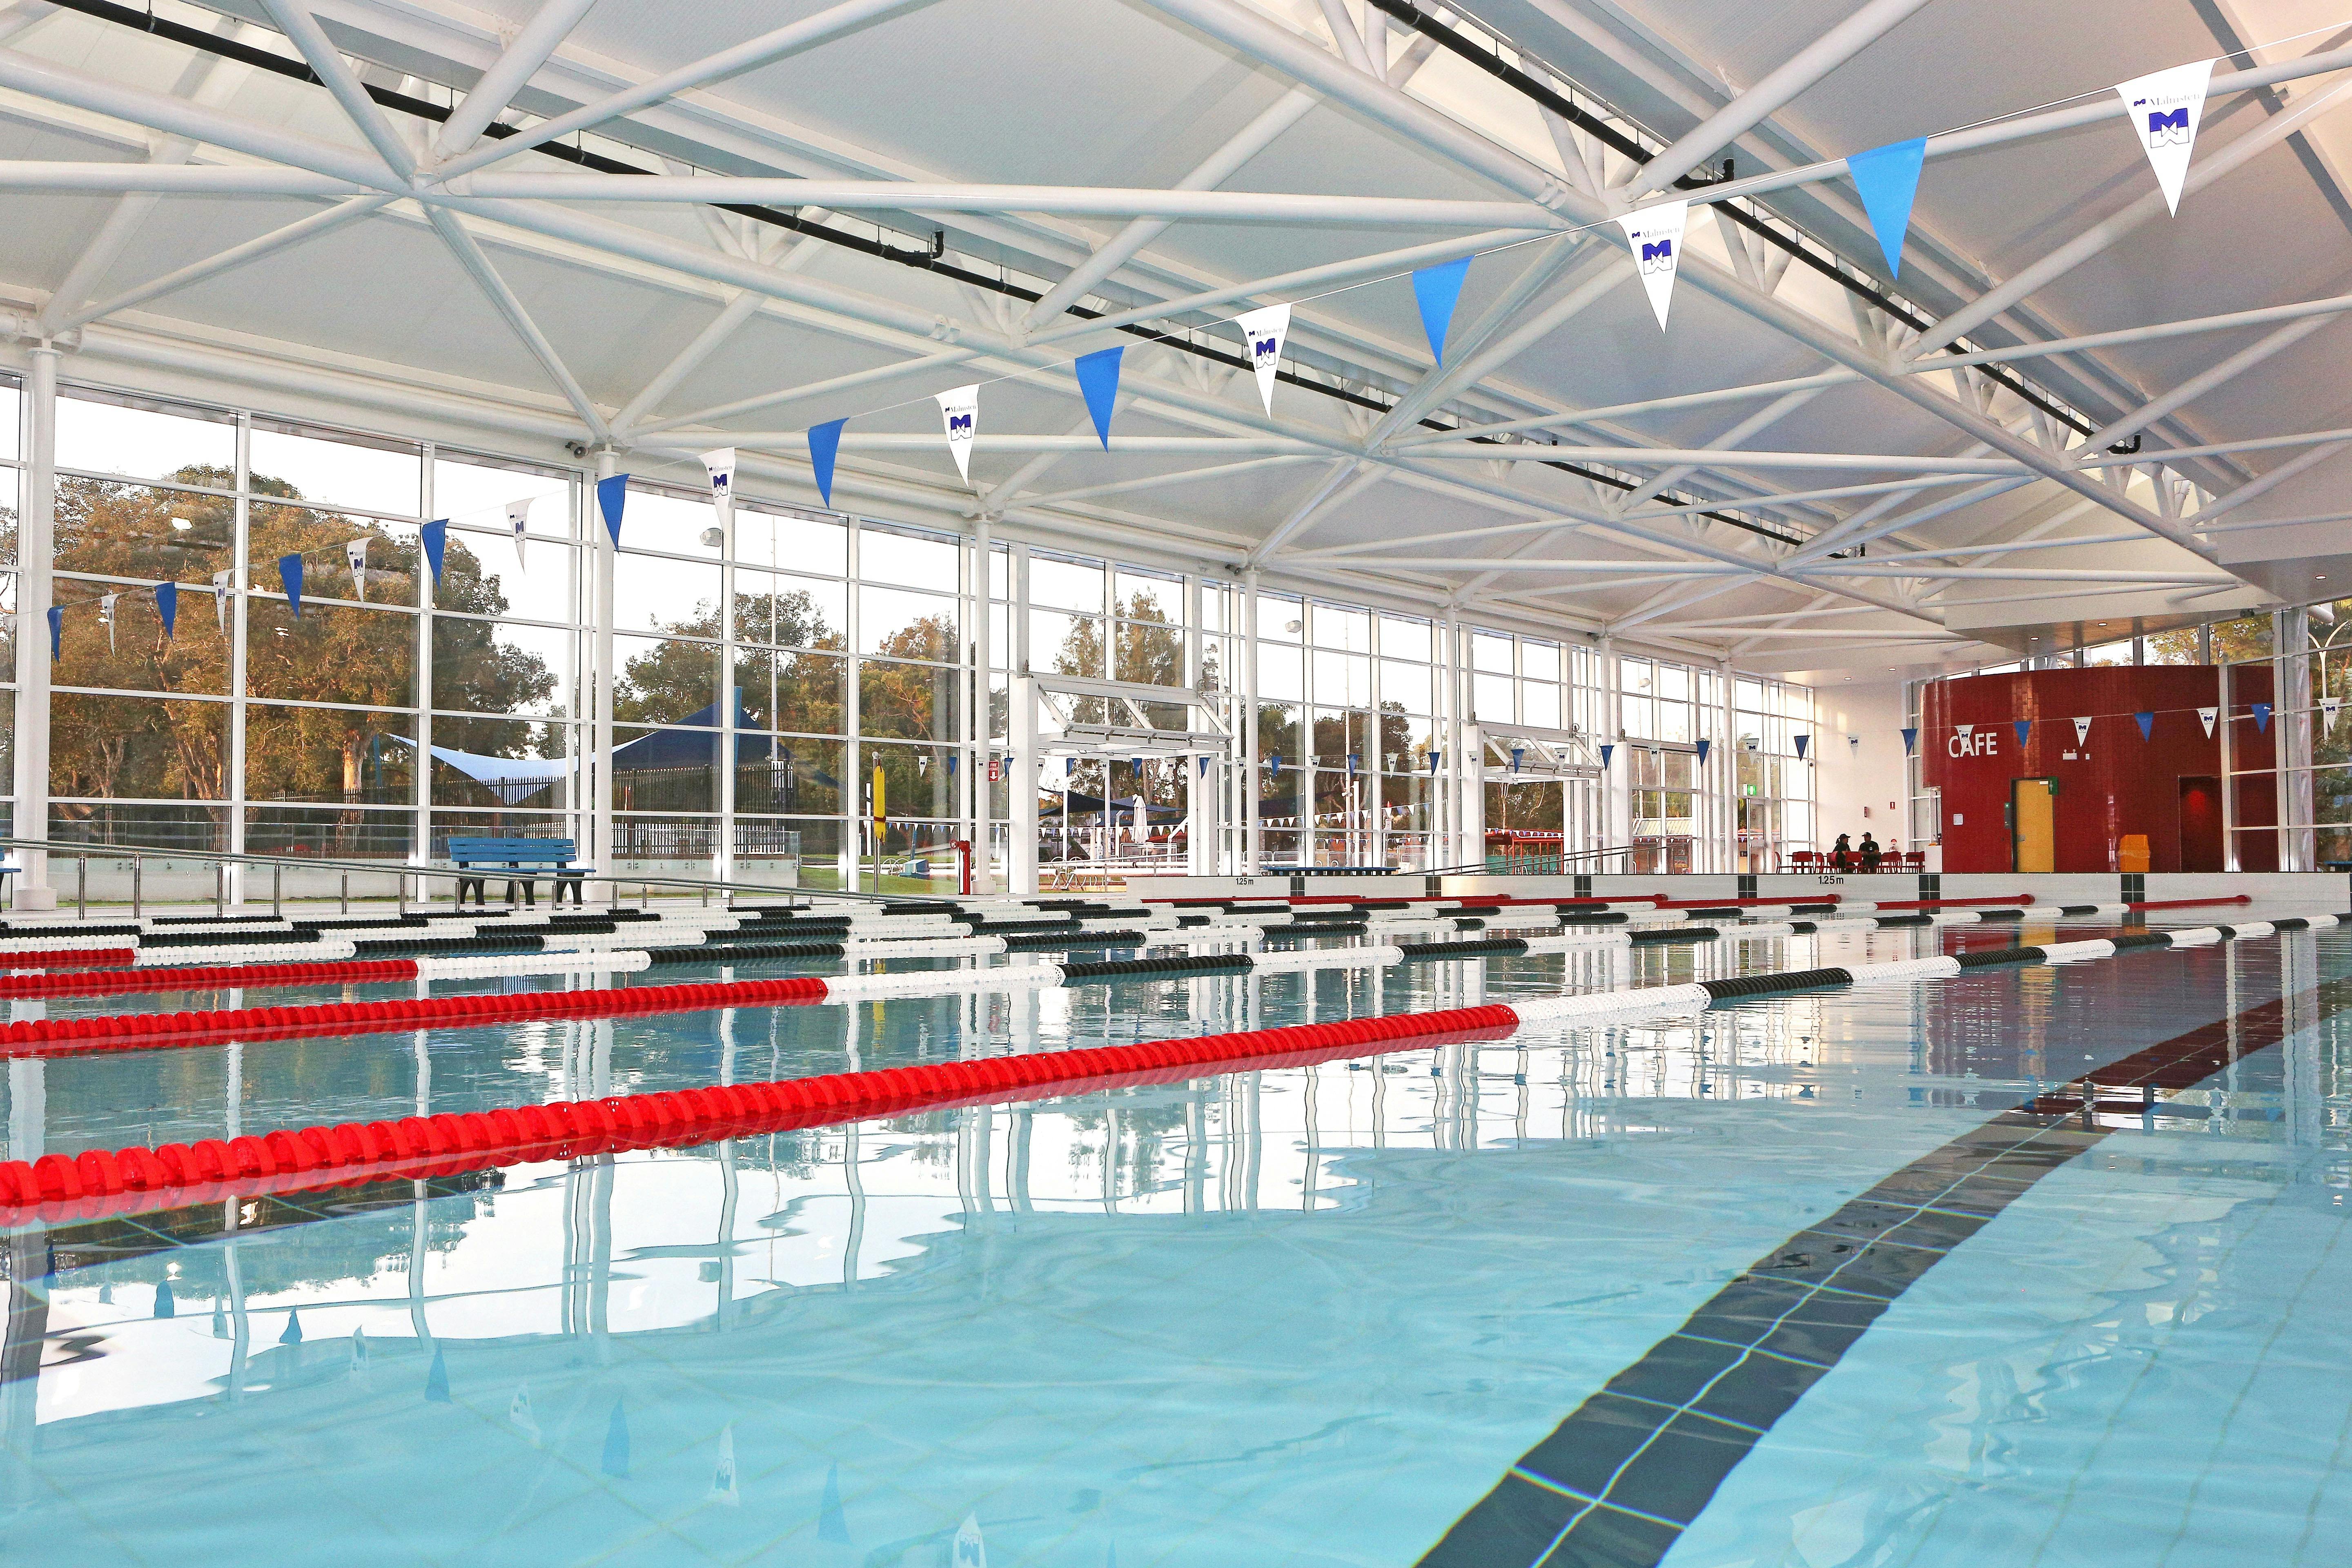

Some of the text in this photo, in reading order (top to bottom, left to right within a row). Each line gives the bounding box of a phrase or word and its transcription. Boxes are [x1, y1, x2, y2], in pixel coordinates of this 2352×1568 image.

[2150, 94, 2200, 106] Malmsten
[1642, 227, 1679, 238] Malmsten
[1949, 733, 1998, 758] CAFE
